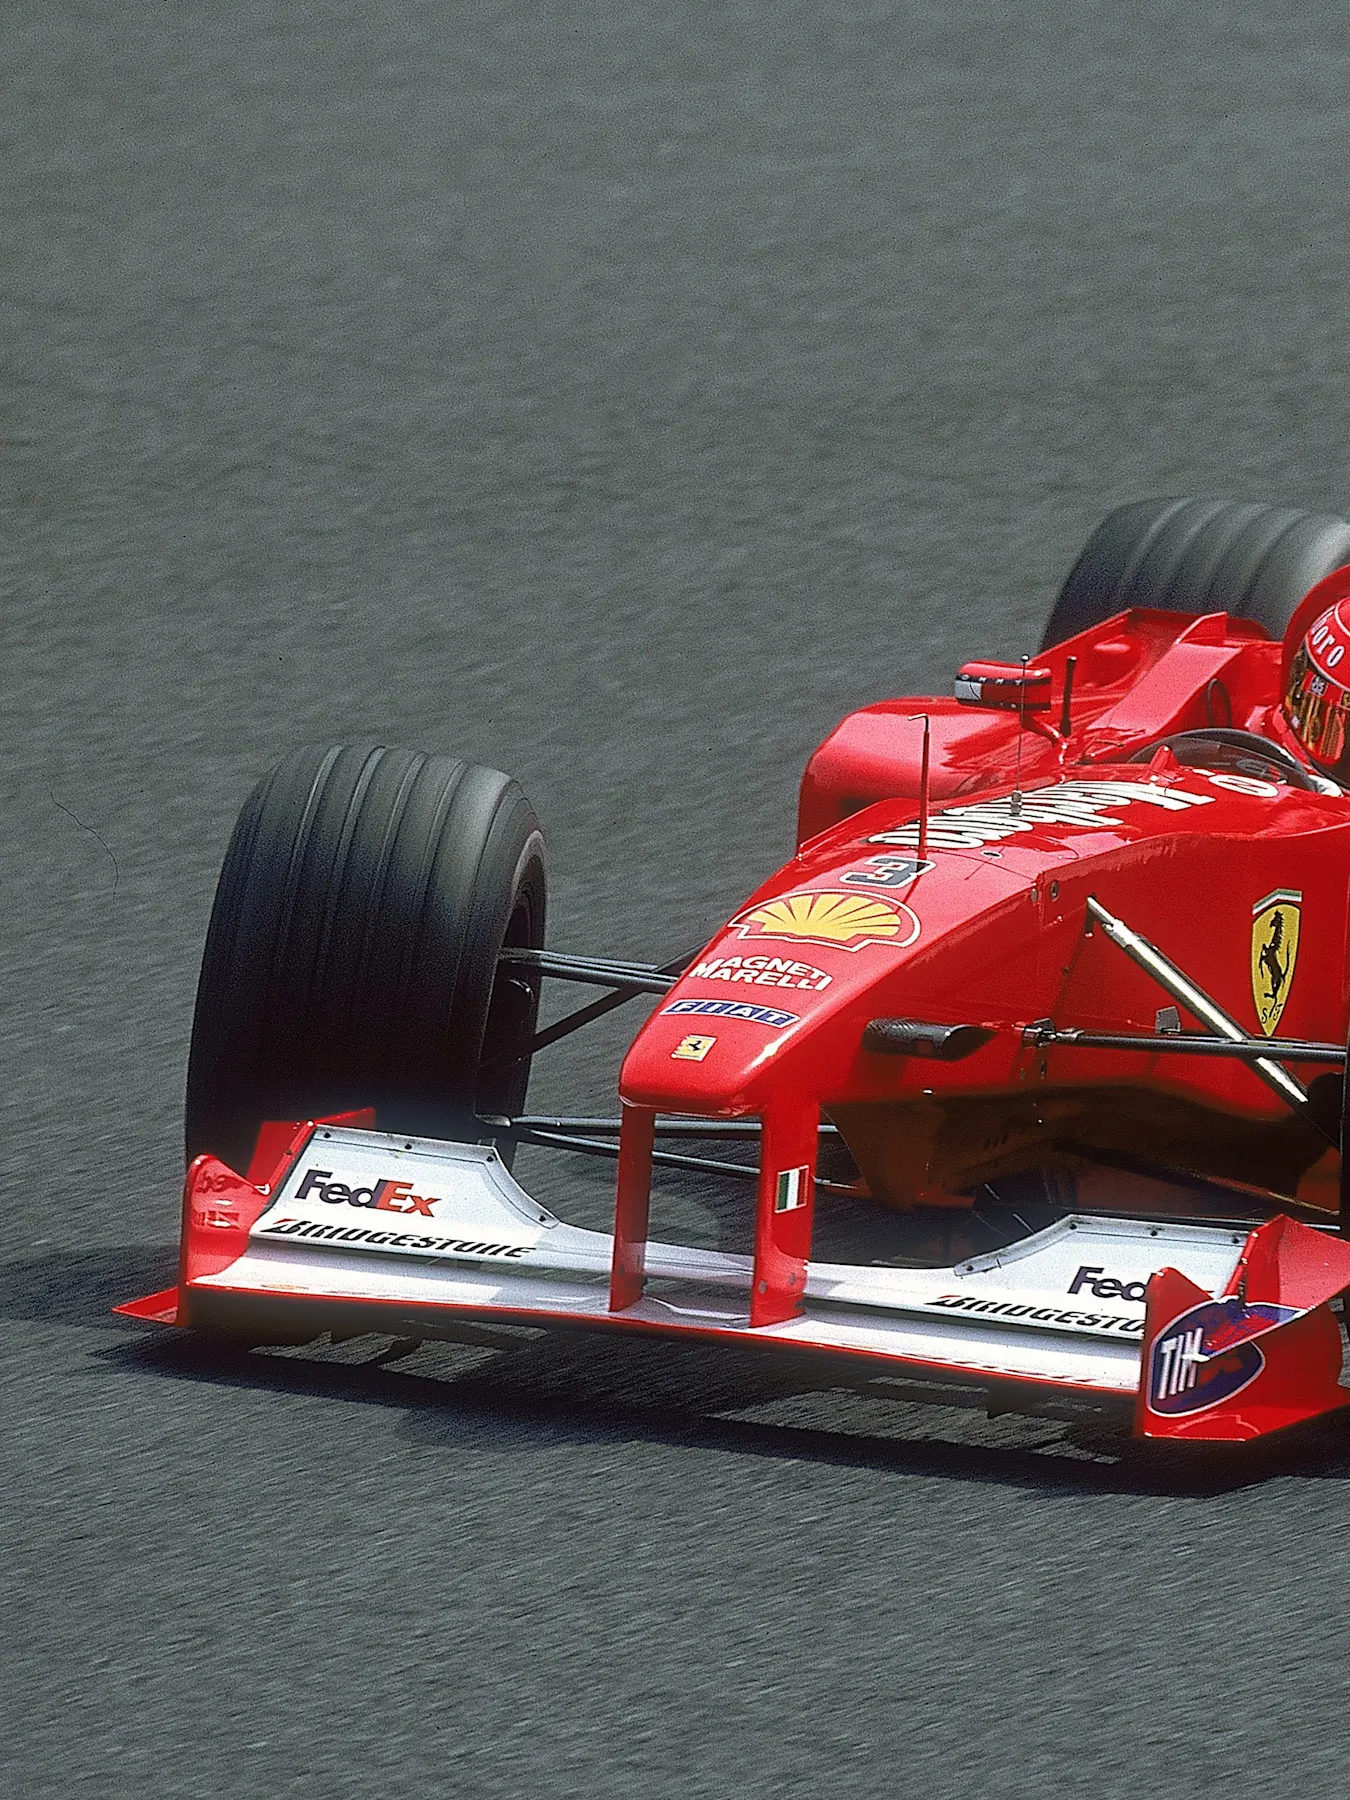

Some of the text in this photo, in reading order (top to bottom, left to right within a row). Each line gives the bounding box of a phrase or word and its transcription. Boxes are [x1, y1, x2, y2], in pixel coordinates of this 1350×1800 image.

[840, 856, 937, 889] 3
[670, 1001, 797, 1027] FIAT
[294, 1168, 443, 1218] FedEx
[260, 1217, 537, 1259] BRIDGESTONE
[1066, 1265, 1156, 1303] Fed
[925, 1294, 1146, 1334] BRIDGESTO
